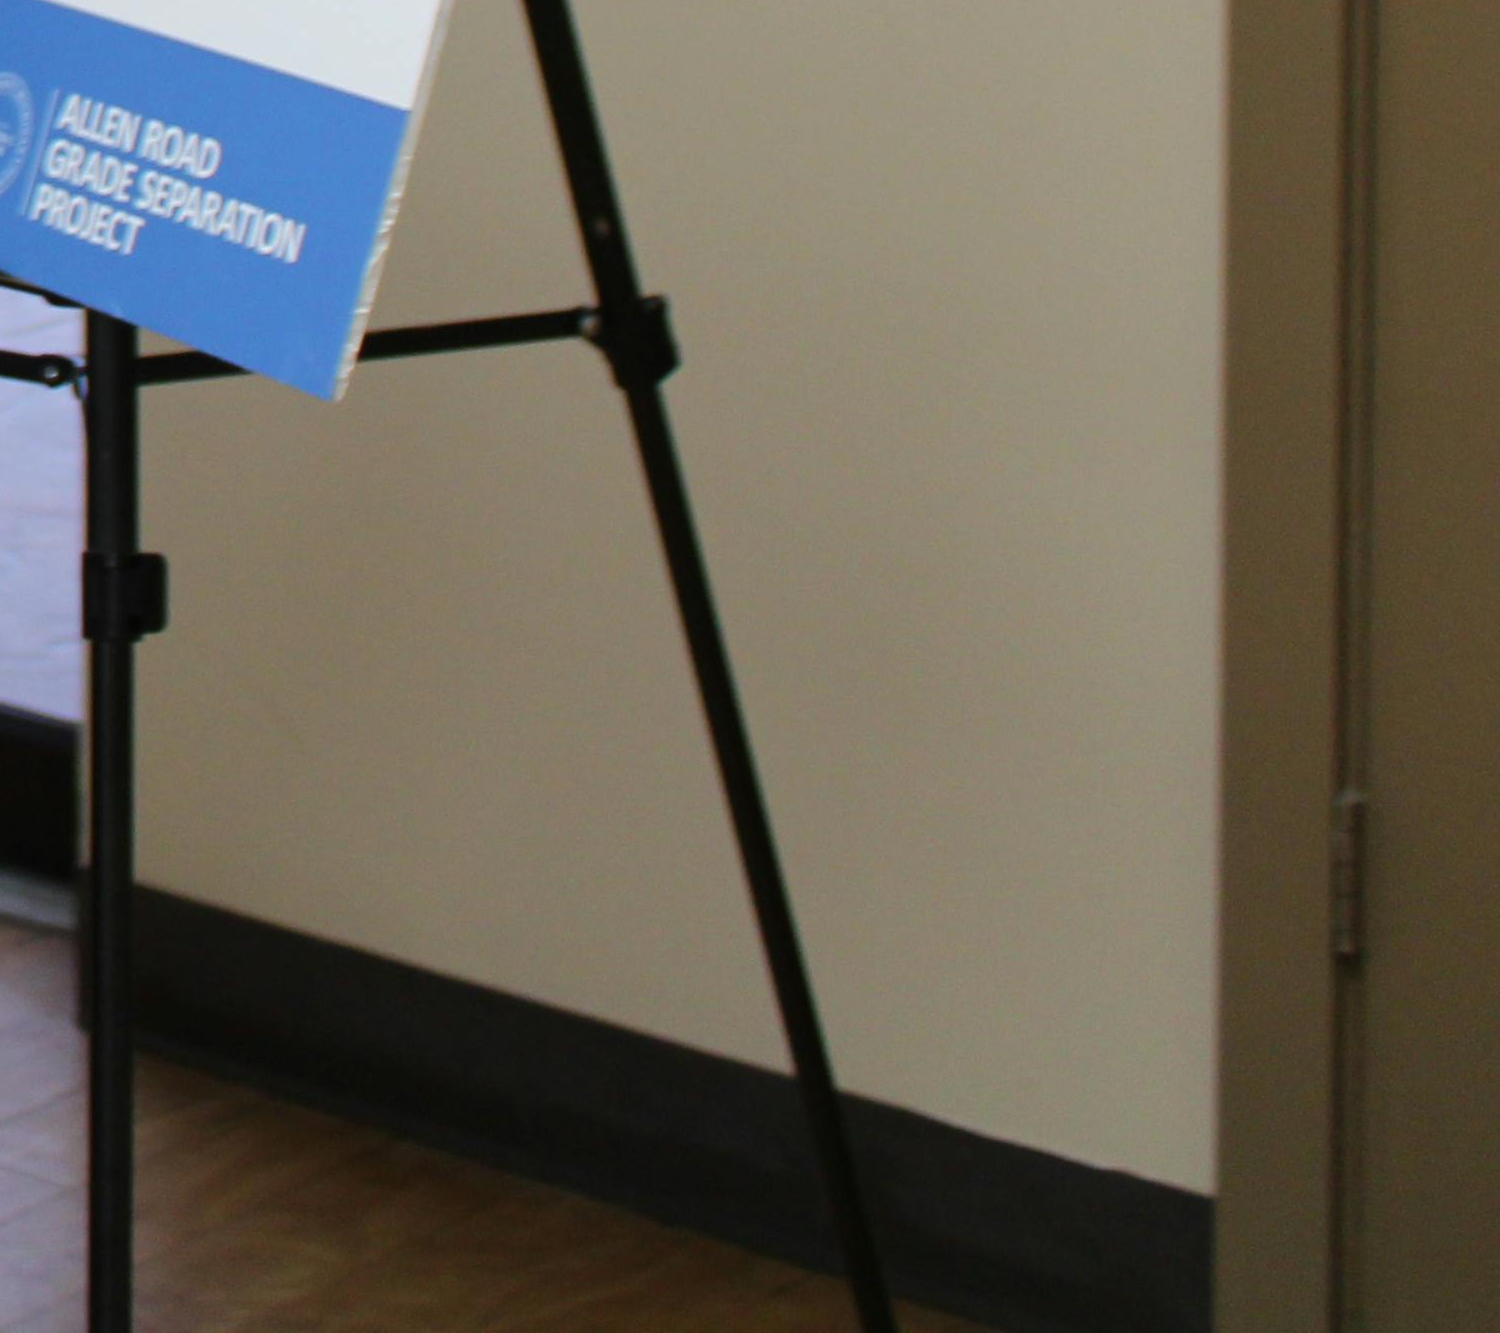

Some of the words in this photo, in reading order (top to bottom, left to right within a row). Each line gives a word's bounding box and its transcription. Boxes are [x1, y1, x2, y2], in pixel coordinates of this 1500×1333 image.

[56, 93, 142, 153] ALLEN
[139, 118, 221, 180] ROAD
[28, 183, 146, 256] PROJECT
[43, 138, 139, 203] GRADE
[133, 169, 307, 264] SEPARATION
